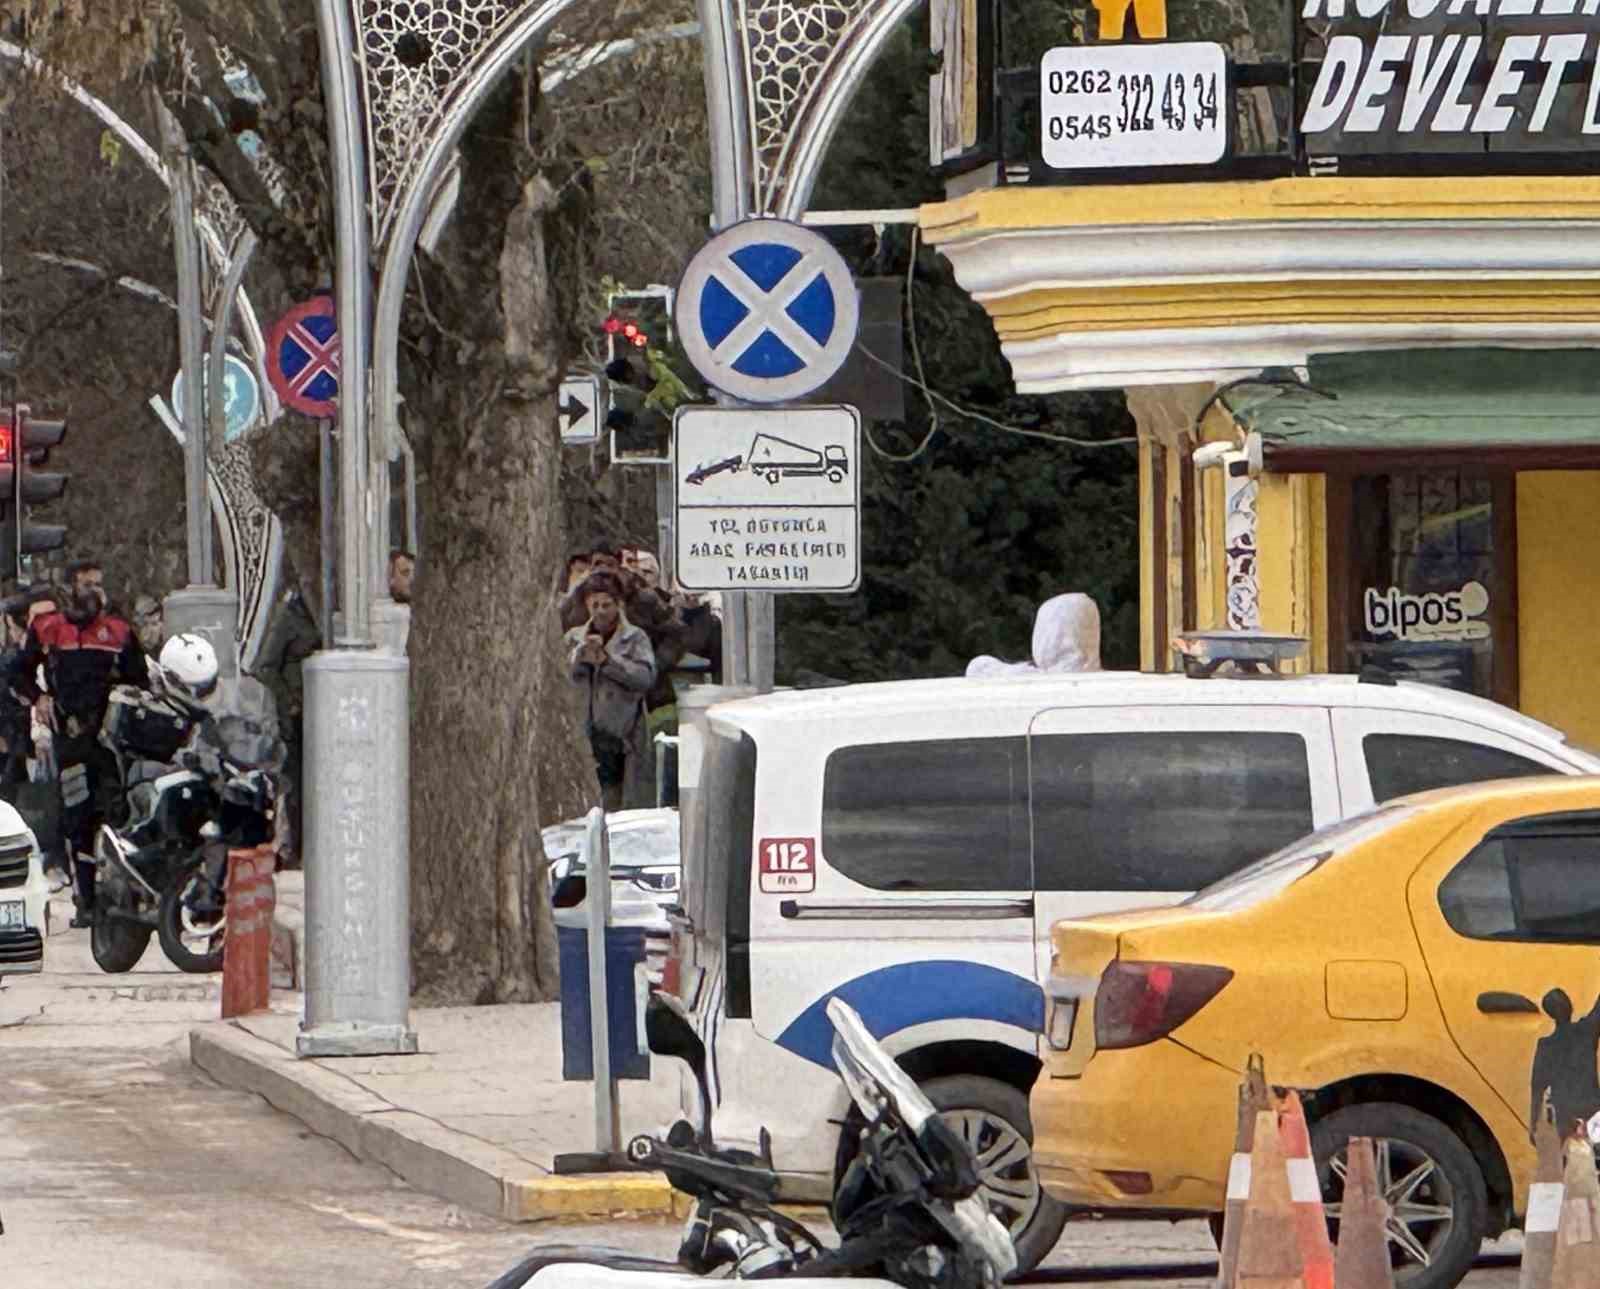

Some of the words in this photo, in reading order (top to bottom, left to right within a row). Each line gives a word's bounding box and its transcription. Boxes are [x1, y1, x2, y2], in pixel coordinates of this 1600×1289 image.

[1049, 69, 1112, 95] 0262
[1300, 34, 1587, 132] DEVLET
[766, 843, 809, 871] 112
